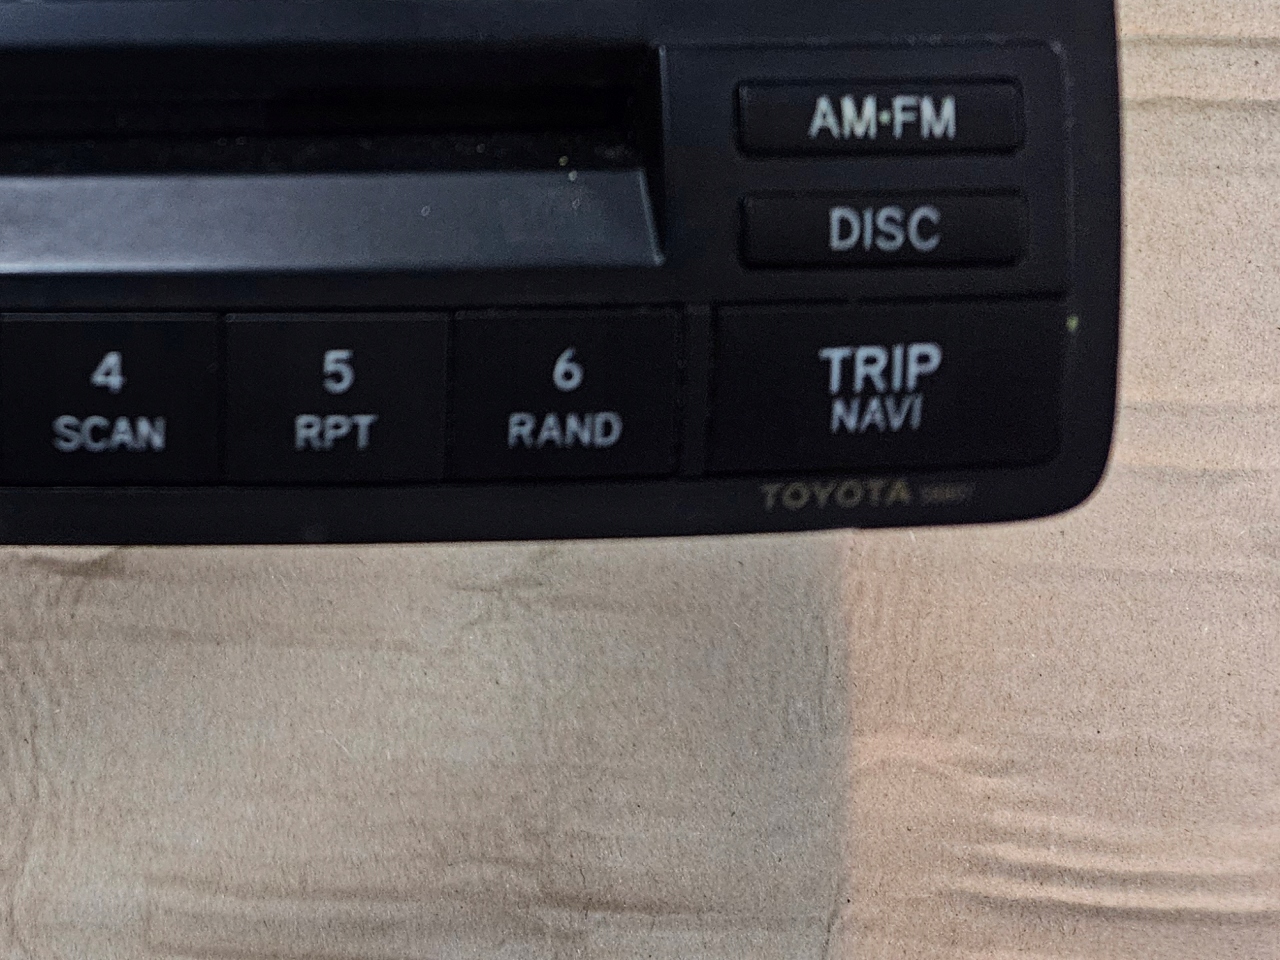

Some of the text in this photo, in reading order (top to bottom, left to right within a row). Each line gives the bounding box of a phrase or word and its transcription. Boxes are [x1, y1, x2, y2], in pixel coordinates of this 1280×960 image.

[828, 206, 942, 253] DISC
[91, 350, 125, 393] 4
[322, 349, 356, 394] 5
[552, 347, 583, 392] 6
[819, 342, 942, 395] TRIP
[53, 415, 166, 452] SCAN
[296, 413, 379, 451] RPT
[507, 411, 623, 448] RAND
[831, 395, 924, 434] NAVI
[762, 479, 911, 510] TOYOTA
